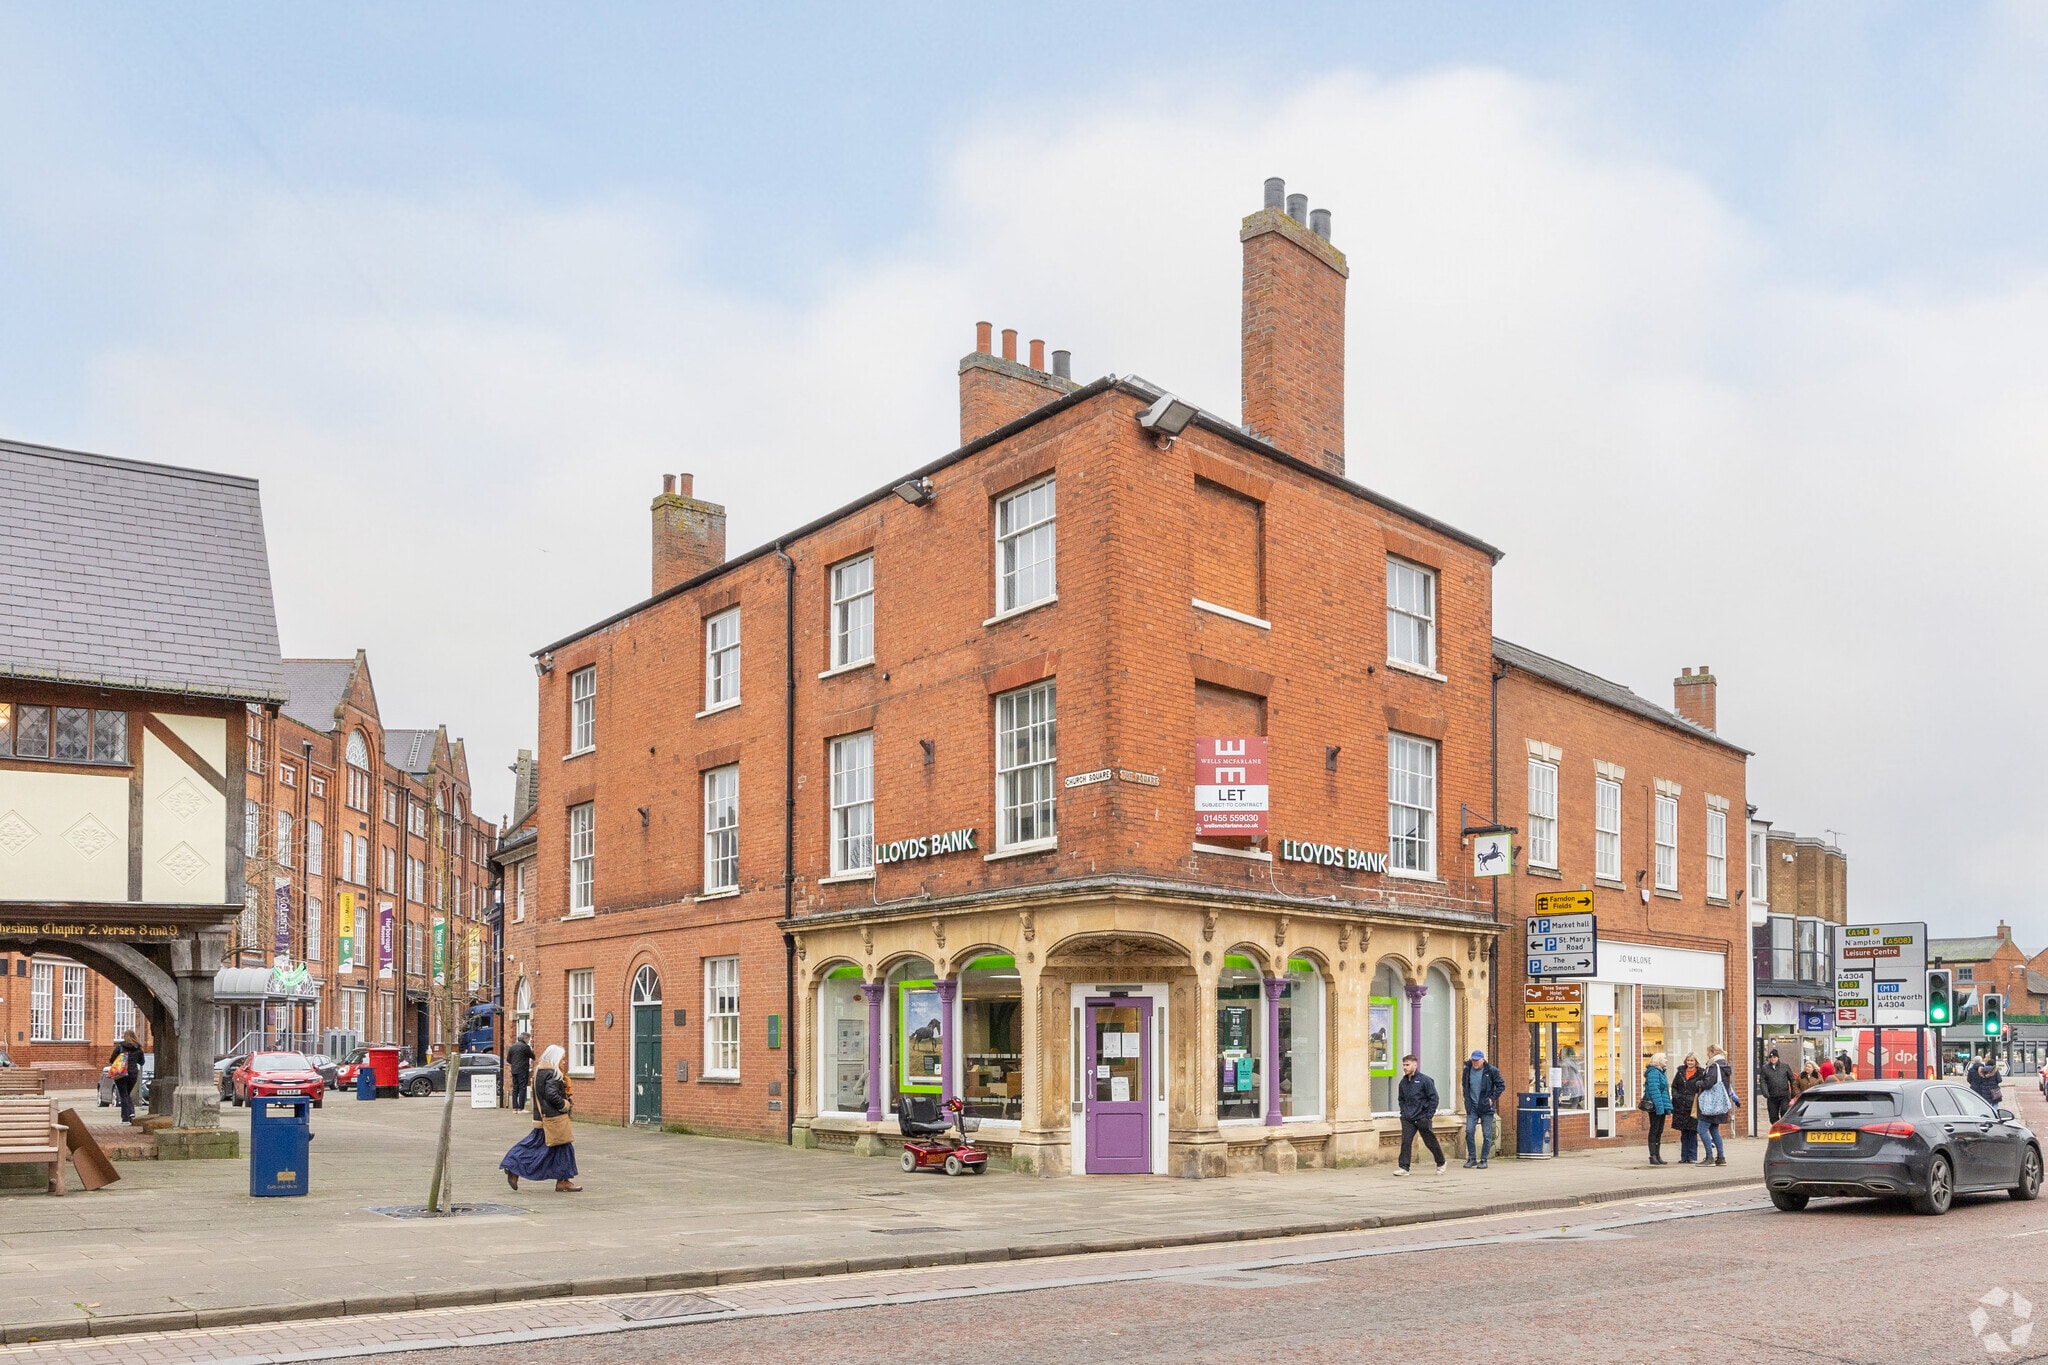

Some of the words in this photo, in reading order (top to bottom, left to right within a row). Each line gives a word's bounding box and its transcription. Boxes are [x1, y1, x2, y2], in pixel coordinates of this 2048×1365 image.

[1066, 776, 1087, 786] CHURCH
[1089, 770, 1111, 781] SQUARE
[1218, 789, 1246, 801] LET
[1203, 814, 1228, 822] 01455
[1229, 814, 1259, 822] 559030
[876, 836, 928, 864] LLOYDS
[931, 828, 975, 856] BANK
[1282, 839, 1345, 868] LLOYDS
[1347, 848, 1389, 873] BANK
[42, 922, 86, 938] Chapter
[102, 922, 136, 935] verses
[139, 924, 148, 936] 8
[149, 925, 168, 936] and
[1569, 935, 1591, 944] Mary's
[1845, 949, 1871, 957] Leisure
[1872, 948, 1898, 956] Centre
[1619, 954, 1627, 963] JO
[1627, 955, 1652, 965] MALONE
[1834, 1132, 1852, 1141] LZC
